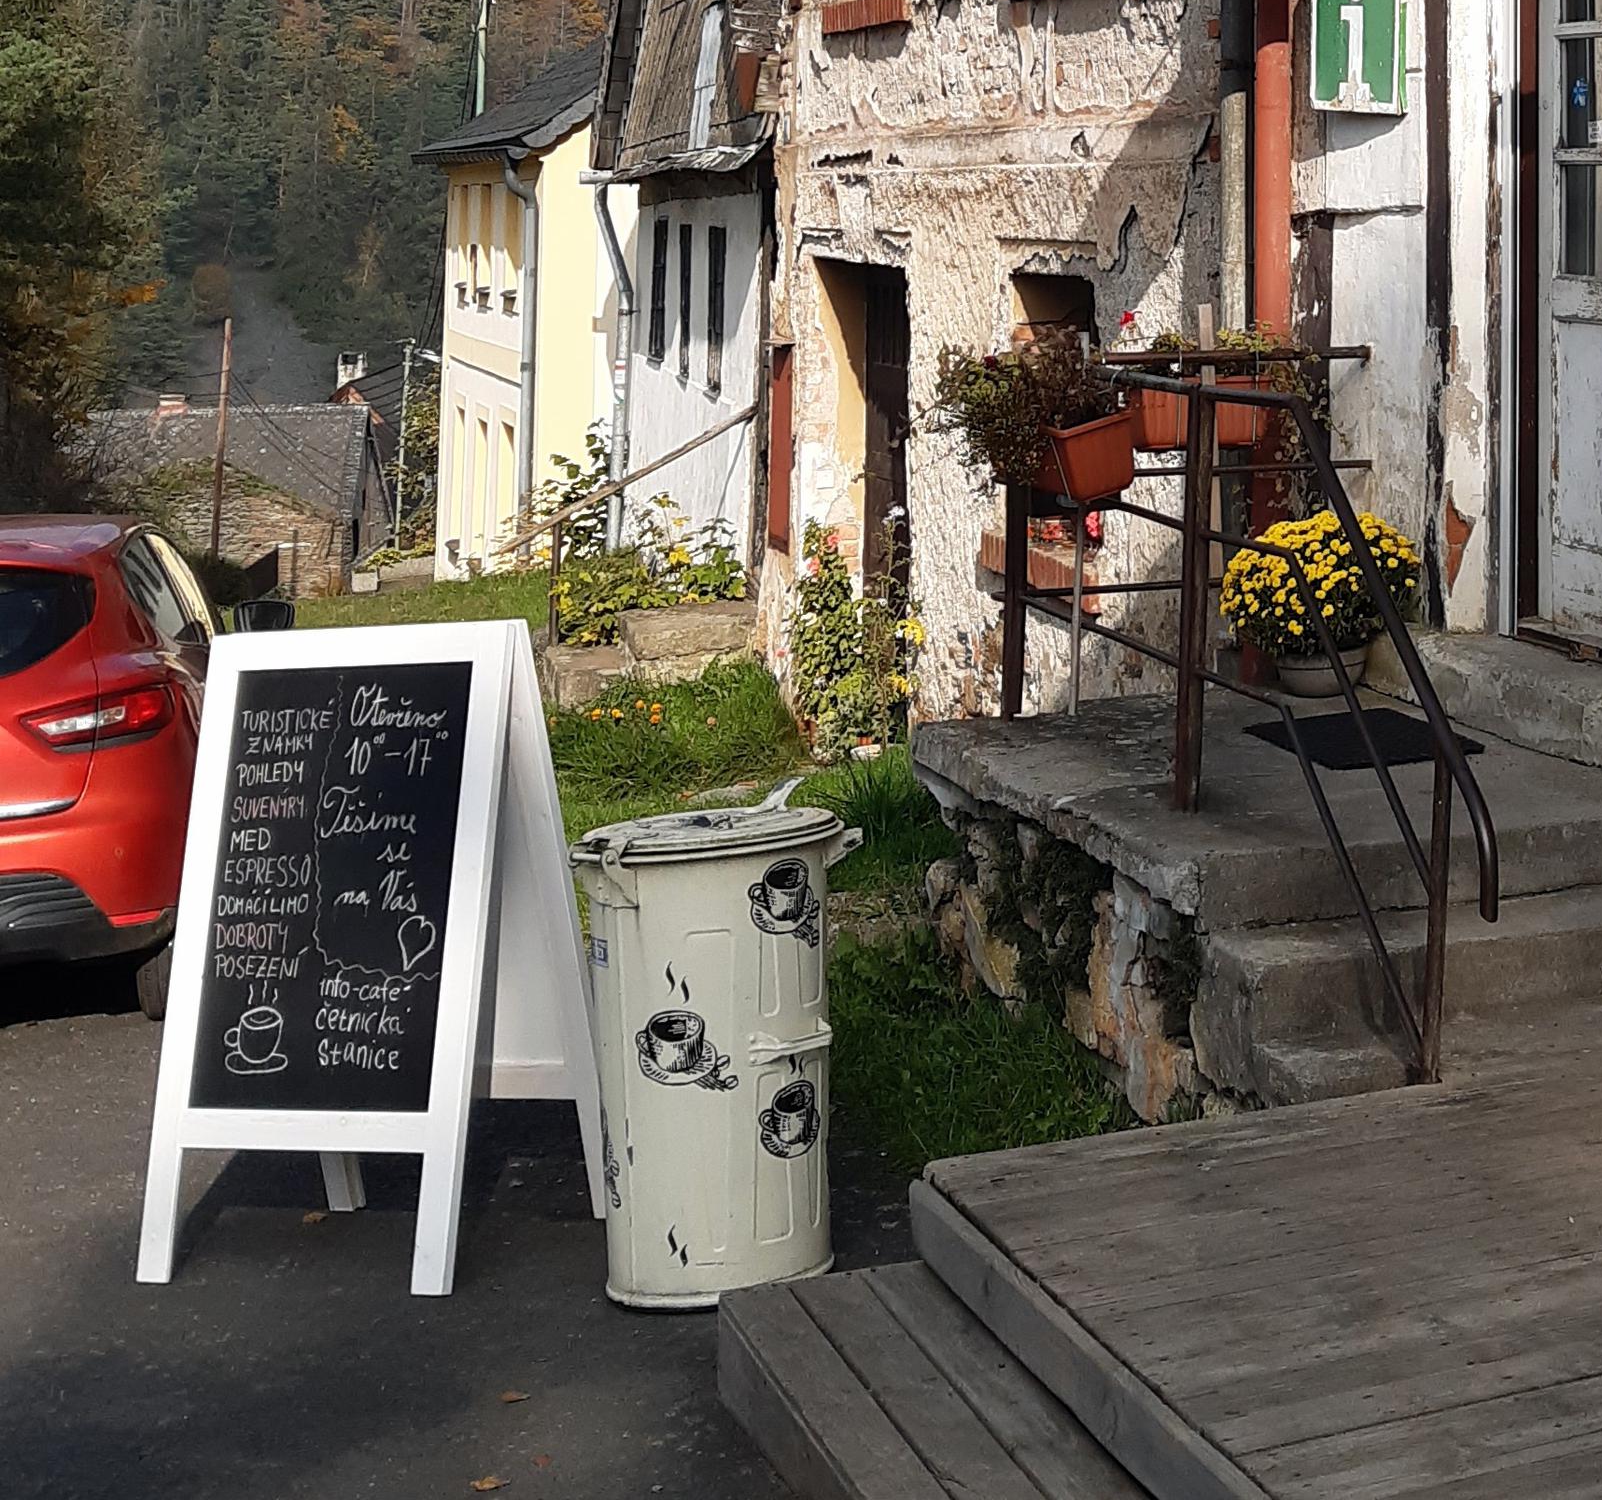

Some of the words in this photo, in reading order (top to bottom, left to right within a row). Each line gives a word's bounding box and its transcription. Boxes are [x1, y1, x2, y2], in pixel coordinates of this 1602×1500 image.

[241, 698, 335, 734] TURISTICKÉ
[350, 682, 447, 727] Otevřeno
[245, 731, 313, 755] ZNÁMKY
[235, 760, 304, 787] POHLEDY
[320, 785, 417, 839] Těšíme
[230, 827, 271, 852] MED
[376, 842, 412, 863] se
[224, 853, 312, 888] ESPRESSO
[270, 893, 309, 915] LIMO
[378, 869, 418, 913] Vás
[214, 921, 289, 954] DOBROTY
[214, 946, 310, 980] POSEZENÍ
[315, 1001, 412, 1035] četnická
